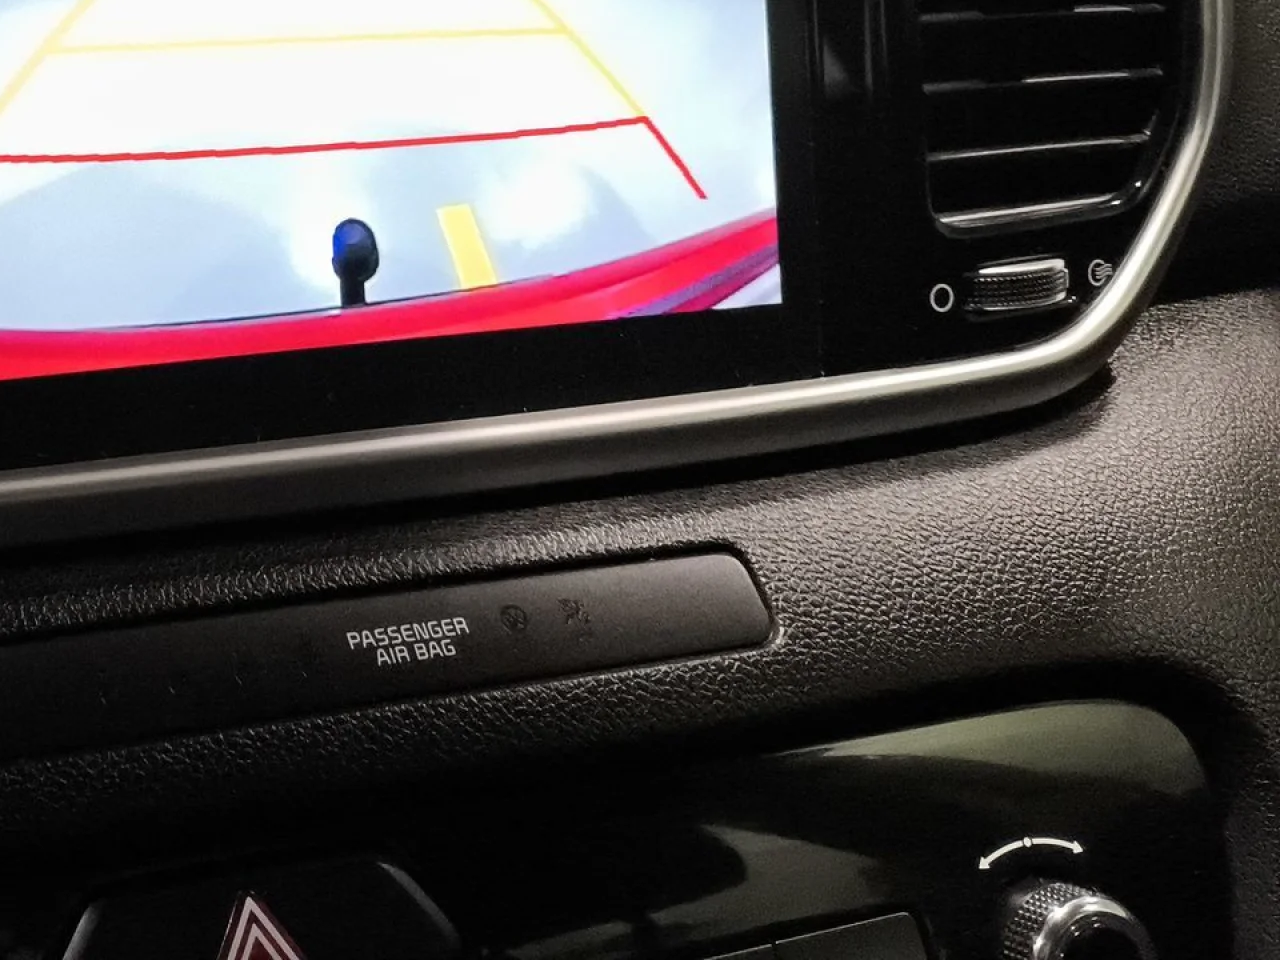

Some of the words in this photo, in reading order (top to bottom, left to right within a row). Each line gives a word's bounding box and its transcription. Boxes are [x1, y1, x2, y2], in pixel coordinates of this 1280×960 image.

[346, 617, 470, 650] PASSENGER
[376, 646, 410, 666] AIR
[414, 639, 457, 660] BAG
